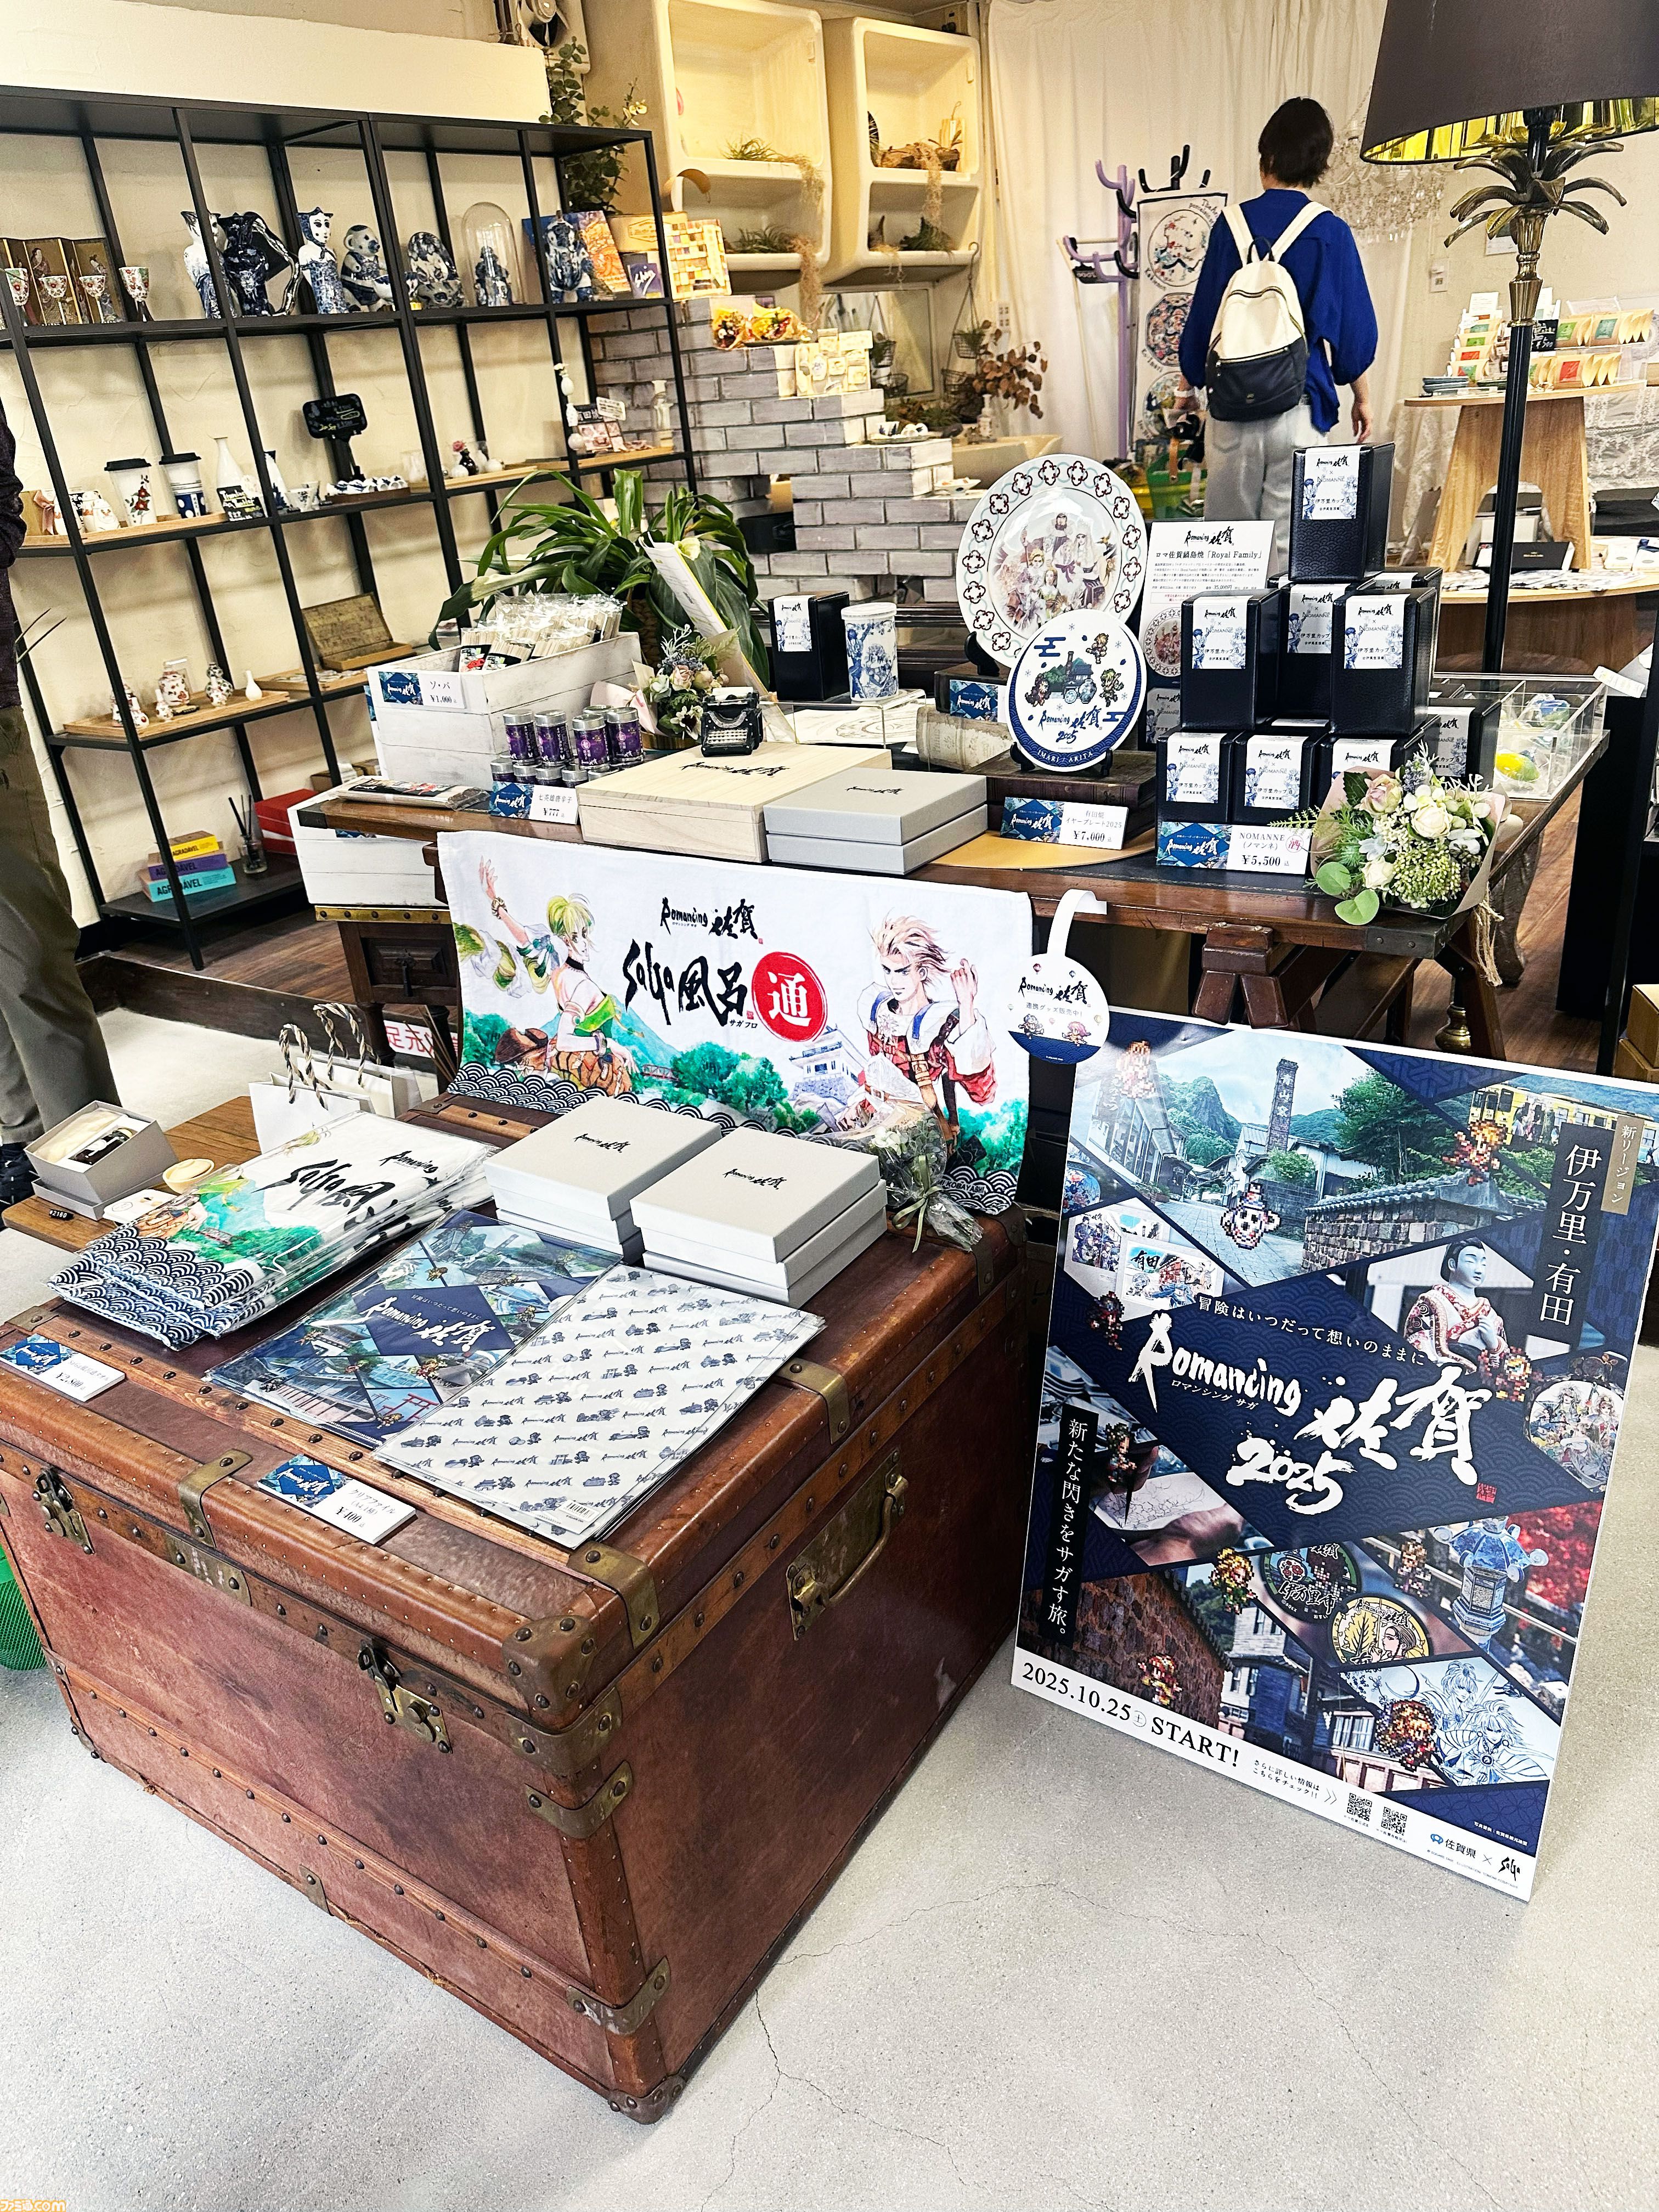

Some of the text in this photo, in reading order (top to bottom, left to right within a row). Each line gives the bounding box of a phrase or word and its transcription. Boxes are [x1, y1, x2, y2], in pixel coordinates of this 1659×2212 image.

[1209, 526, 1234, 545] 佐賀
[430, 695, 452, 703] ¥1,000
[1038, 706, 1102, 731] Romancing 佐賀
[1056, 730, 1078, 744] 2025
[1037, 750, 1093, 763] IMARI ARITA
[543, 808, 560, 817] ¥777
[1066, 819, 1122, 828] イヤープレート2025
[1086, 810, 1105, 819] 有田焼
[1074, 831, 1105, 842] ¥7,000
[1239, 832, 1285, 841] NOMANNE
[1243, 842, 1278, 850] (ノマンネ)
[1288, 839, 1300, 851] 酒
[1242, 855, 1280, 866] ¥5,500
[660, 897, 758, 940] Romancing 佐賀
[767, 972, 812, 1028] 通
[1018, 977, 1088, 1005] Romancing 佐賀
[379, 1150, 440, 1173] Romancing
[1610, 1124, 1638, 1204] 新リージョン
[946, 1181, 985, 1194] KOBAYASHI
[1539, 1143, 1602, 1327] 伊万里・有田
[1131, 1250, 1161, 1273] 有田
[359, 1296, 496, 1352] Romancing 佐賀
[1199, 1295, 1426, 1366] 冒険はいつだって想いのままに
[1128, 1310, 1494, 1486] Romancing 佐賀
[1171, 1379, 1260, 1410] ロマンシング サガ
[1226, 1437, 1358, 1515] 2025
[348, 1489, 396, 1514] クリアファイル
[336, 1506, 362, 1523] ¥400
[1047, 1418, 1088, 1635] 新たな閃きをサガす旅。
[1278, 1580, 1338, 1615] 伊万里市
[1354, 1598, 1412, 1629] Romancing 佐賀
[1022, 1662, 1132, 1722] 2025.10.25
[1151, 1717, 1239, 1768] START!
[1253, 1768, 1317, 1799] こちらをチェック!!
[1254, 1759, 1319, 1791] さらに詳しい情報は
[1445, 1838, 1476, 1859] 佐賀県
